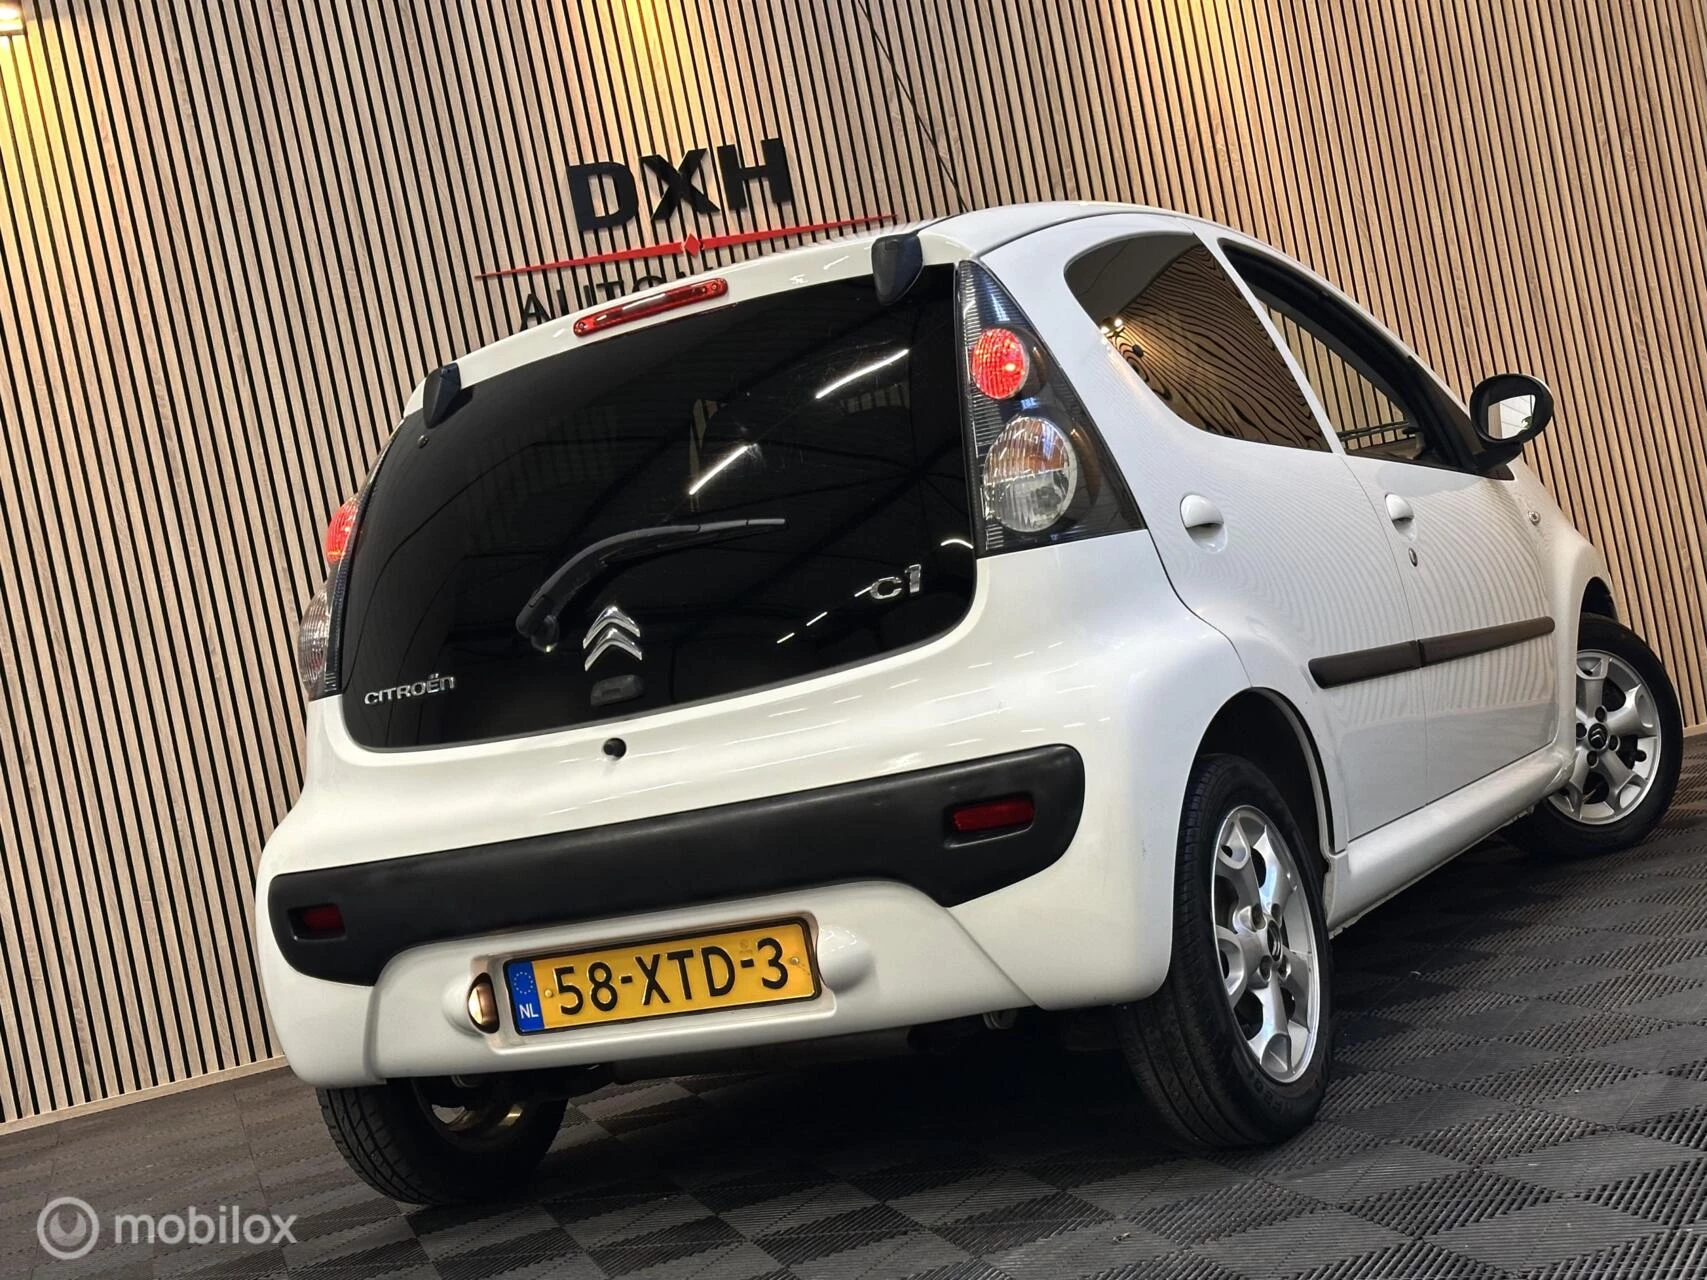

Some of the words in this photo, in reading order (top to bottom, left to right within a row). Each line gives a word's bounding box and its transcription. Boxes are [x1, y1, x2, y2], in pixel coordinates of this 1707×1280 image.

[568, 138, 794, 232] DXH
[518, 1002, 540, 1021] NL
[553, 937, 789, 1015] 58-XTD-3
